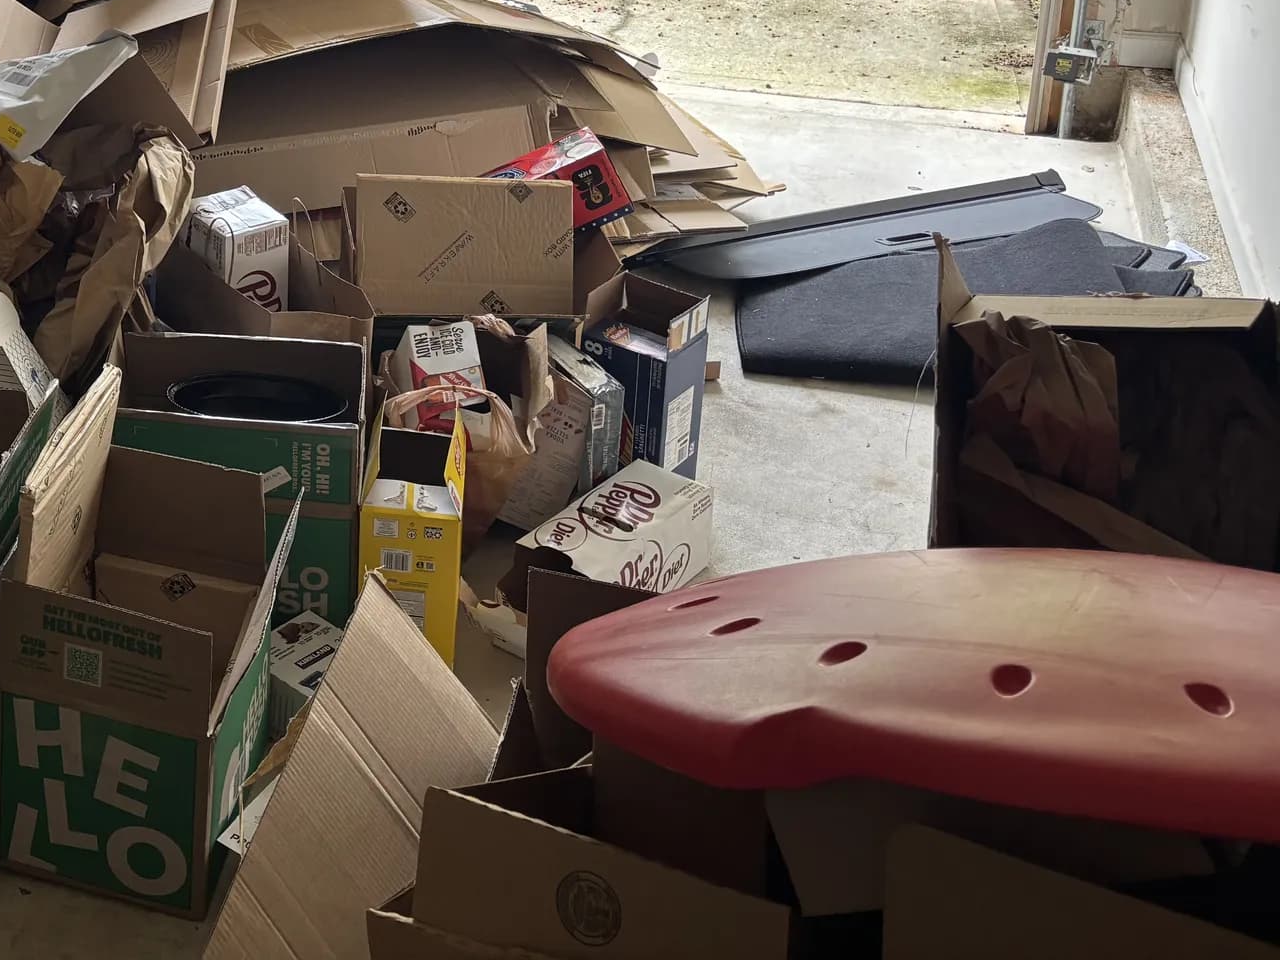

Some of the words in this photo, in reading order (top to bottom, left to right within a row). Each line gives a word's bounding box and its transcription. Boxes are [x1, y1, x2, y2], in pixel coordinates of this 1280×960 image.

[413, 332, 431, 359] ENJOY
[439, 327, 452, 338] ICE
[451, 326, 465, 353] Serve
[440, 338, 455, 355] COLD
[546, 521, 577, 547] Diet
[42, 614, 163, 660] HELLOFRESH
